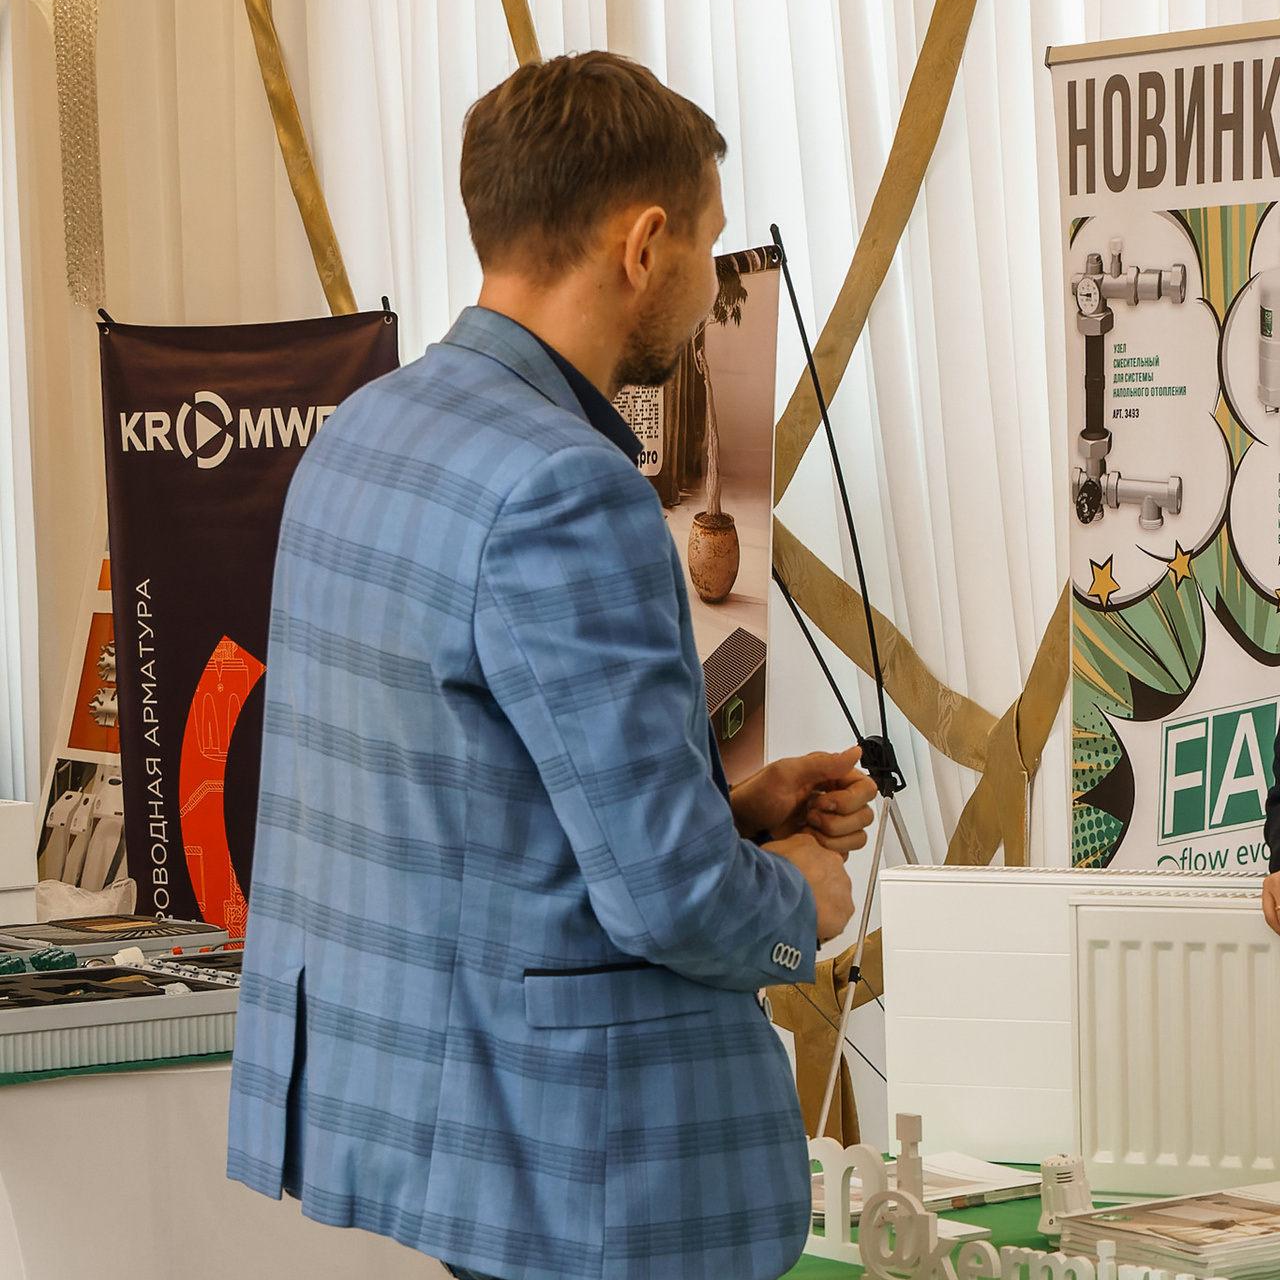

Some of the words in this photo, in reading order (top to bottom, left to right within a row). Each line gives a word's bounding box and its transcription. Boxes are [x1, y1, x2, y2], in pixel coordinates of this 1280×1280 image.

[1113, 343, 1126, 353] УЗЕЛ
[1113, 355, 1160, 368] СМЕСИТЕЛЬНЫЙ
[1113, 373, 1124, 384] ДЛЯ
[1125, 372, 1154, 383] СИСТЕМЫ
[1113, 387, 1149, 398] НАПОЛЬНОГО
[1151, 386, 1187, 397] ОТОПЛЕНИЯ
[1112, 409, 1124, 419] АРТ.
[1124, 408, 1140, 419] 3493
[636, 450, 658, 468] pro
[135, 578, 161, 748] АРМАТУРА
[1180, 847, 1229, 871] flow
